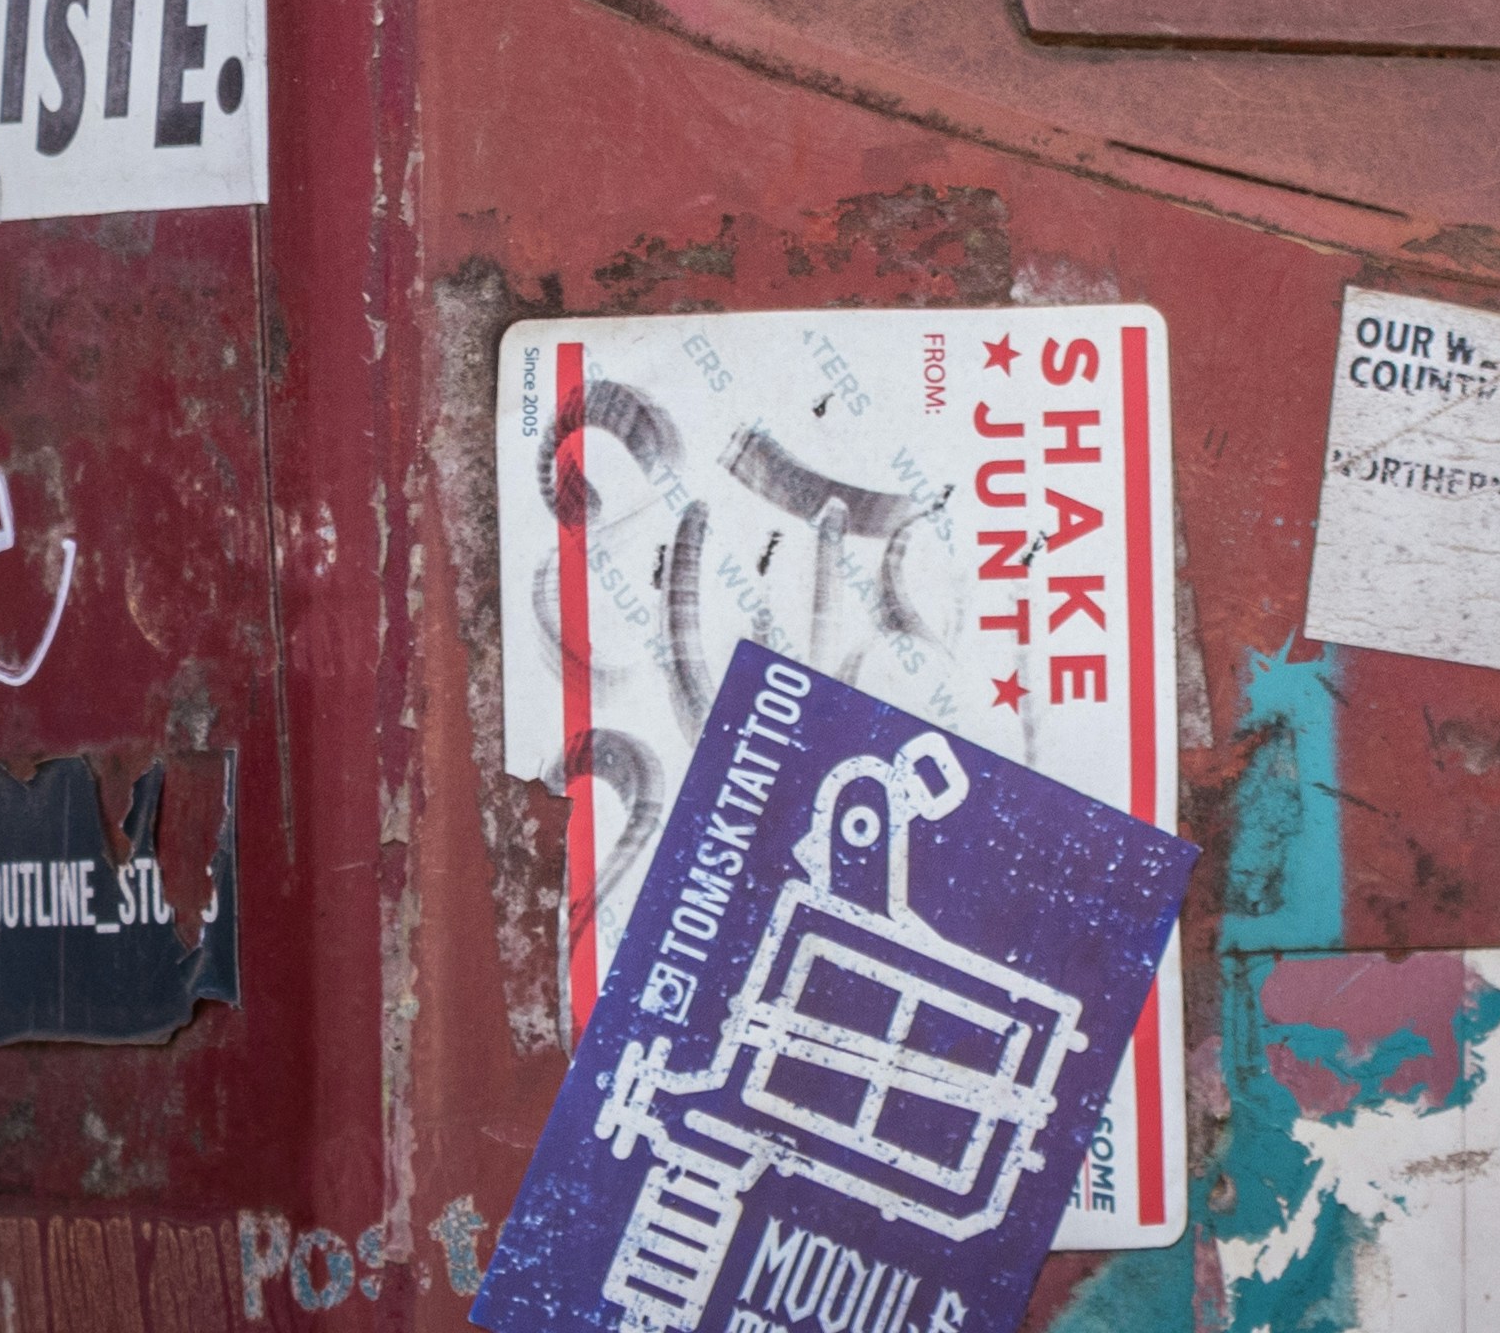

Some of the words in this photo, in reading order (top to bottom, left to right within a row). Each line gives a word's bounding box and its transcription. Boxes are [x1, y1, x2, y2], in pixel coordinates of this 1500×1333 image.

[523, 346, 540, 391] Since
[923, 333, 947, 415] FROM:
[1356, 316, 1435, 359] OUR
[522, 393, 539, 438] 2005
[974, 400, 1031, 646] JUNT
[1041, 336, 1109, 704] SHAKE
[660, 662, 812, 963] TOMSKTATTOO
